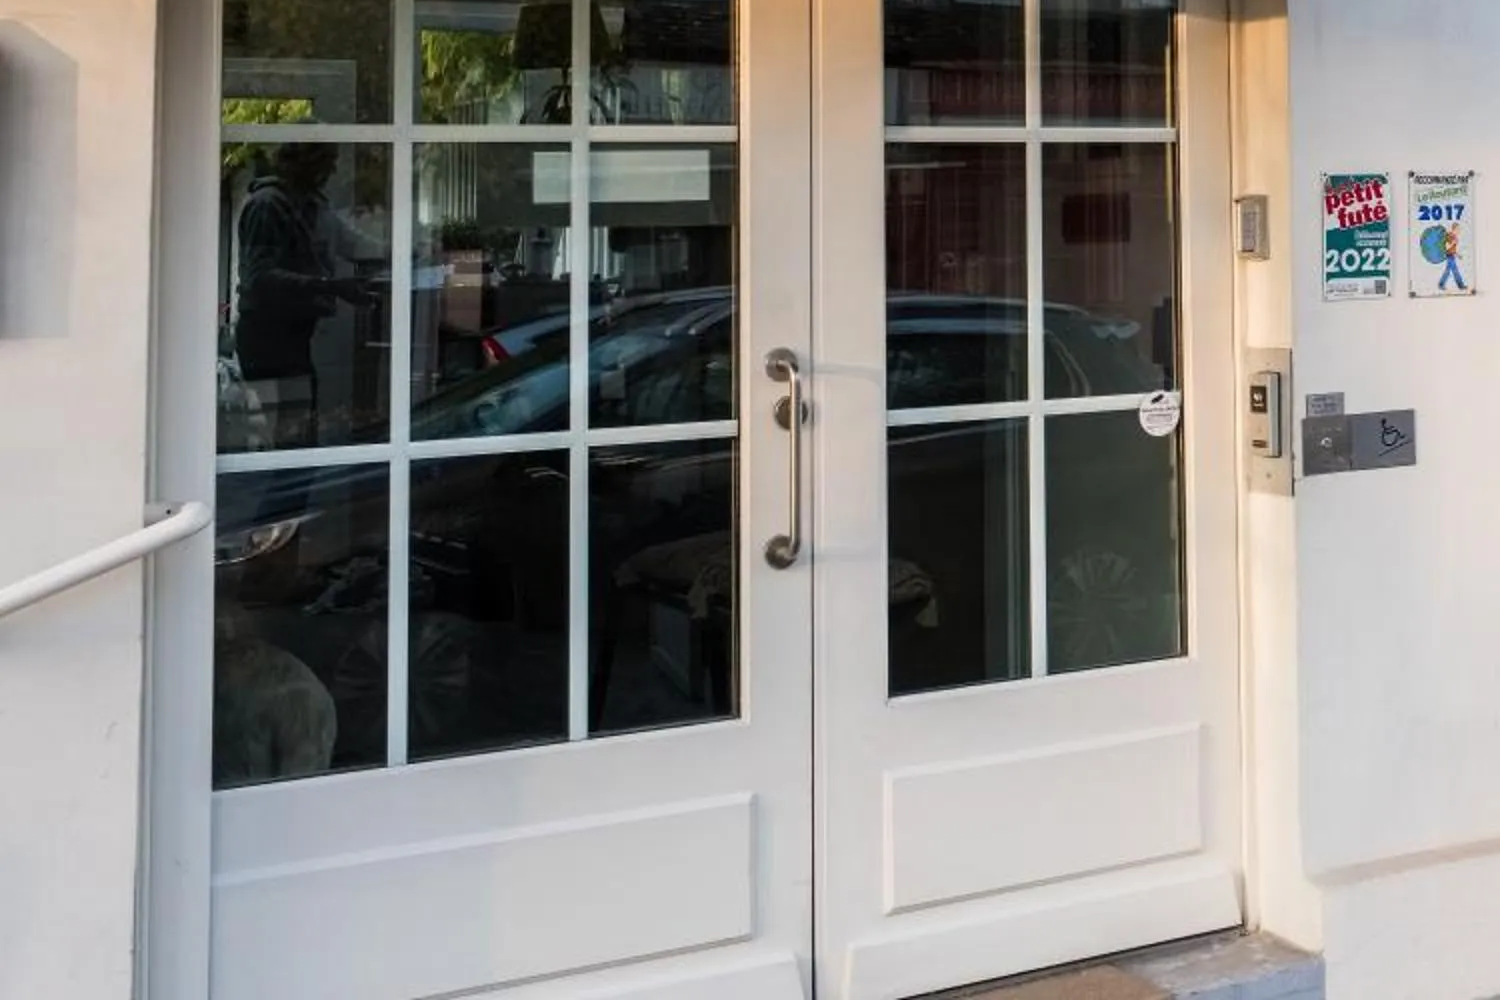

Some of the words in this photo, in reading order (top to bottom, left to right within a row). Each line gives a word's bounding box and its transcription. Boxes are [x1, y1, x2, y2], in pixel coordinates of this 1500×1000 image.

[1325, 180, 1383, 215] petit
[1338, 201, 1388, 229] futé
[1418, 204, 1465, 221] 2017
[1326, 248, 1391, 272] 2022
